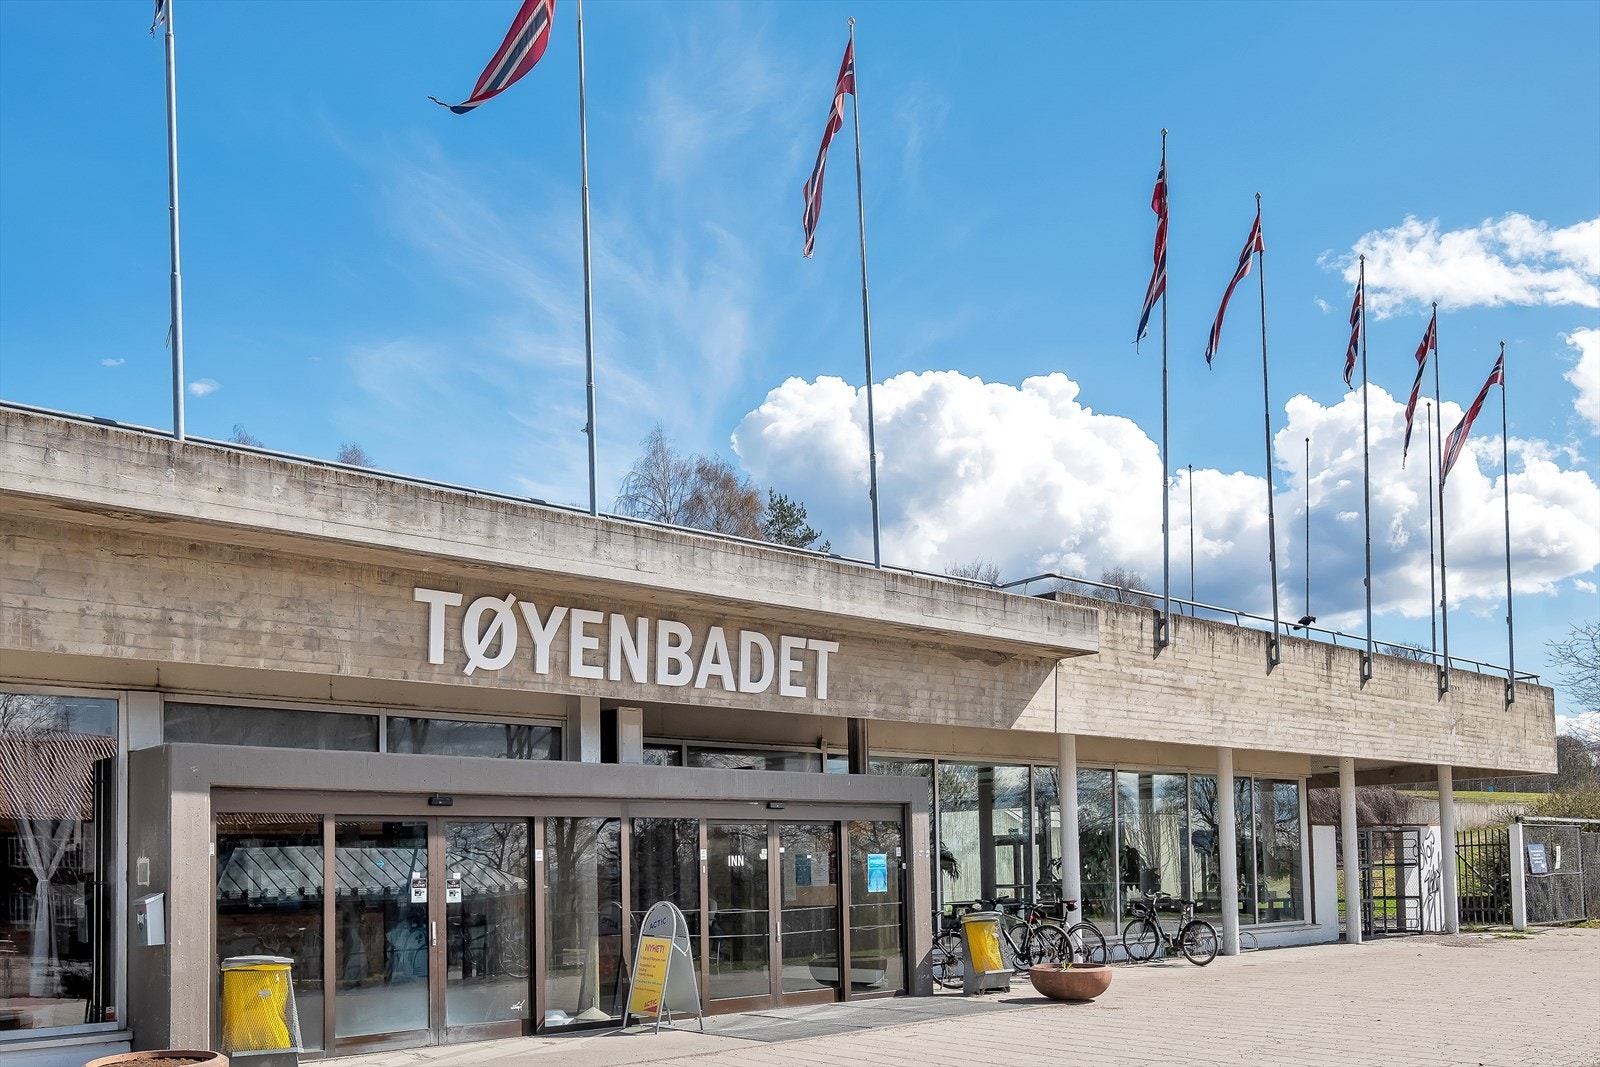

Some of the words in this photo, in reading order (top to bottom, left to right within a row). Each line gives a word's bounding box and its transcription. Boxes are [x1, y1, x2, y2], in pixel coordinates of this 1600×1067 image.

[413, 588, 840, 700] TØYENBADET
[728, 855, 744, 866] INN
[649, 917, 667, 930] ACTIC
[643, 998, 658, 1008] ACTIC
